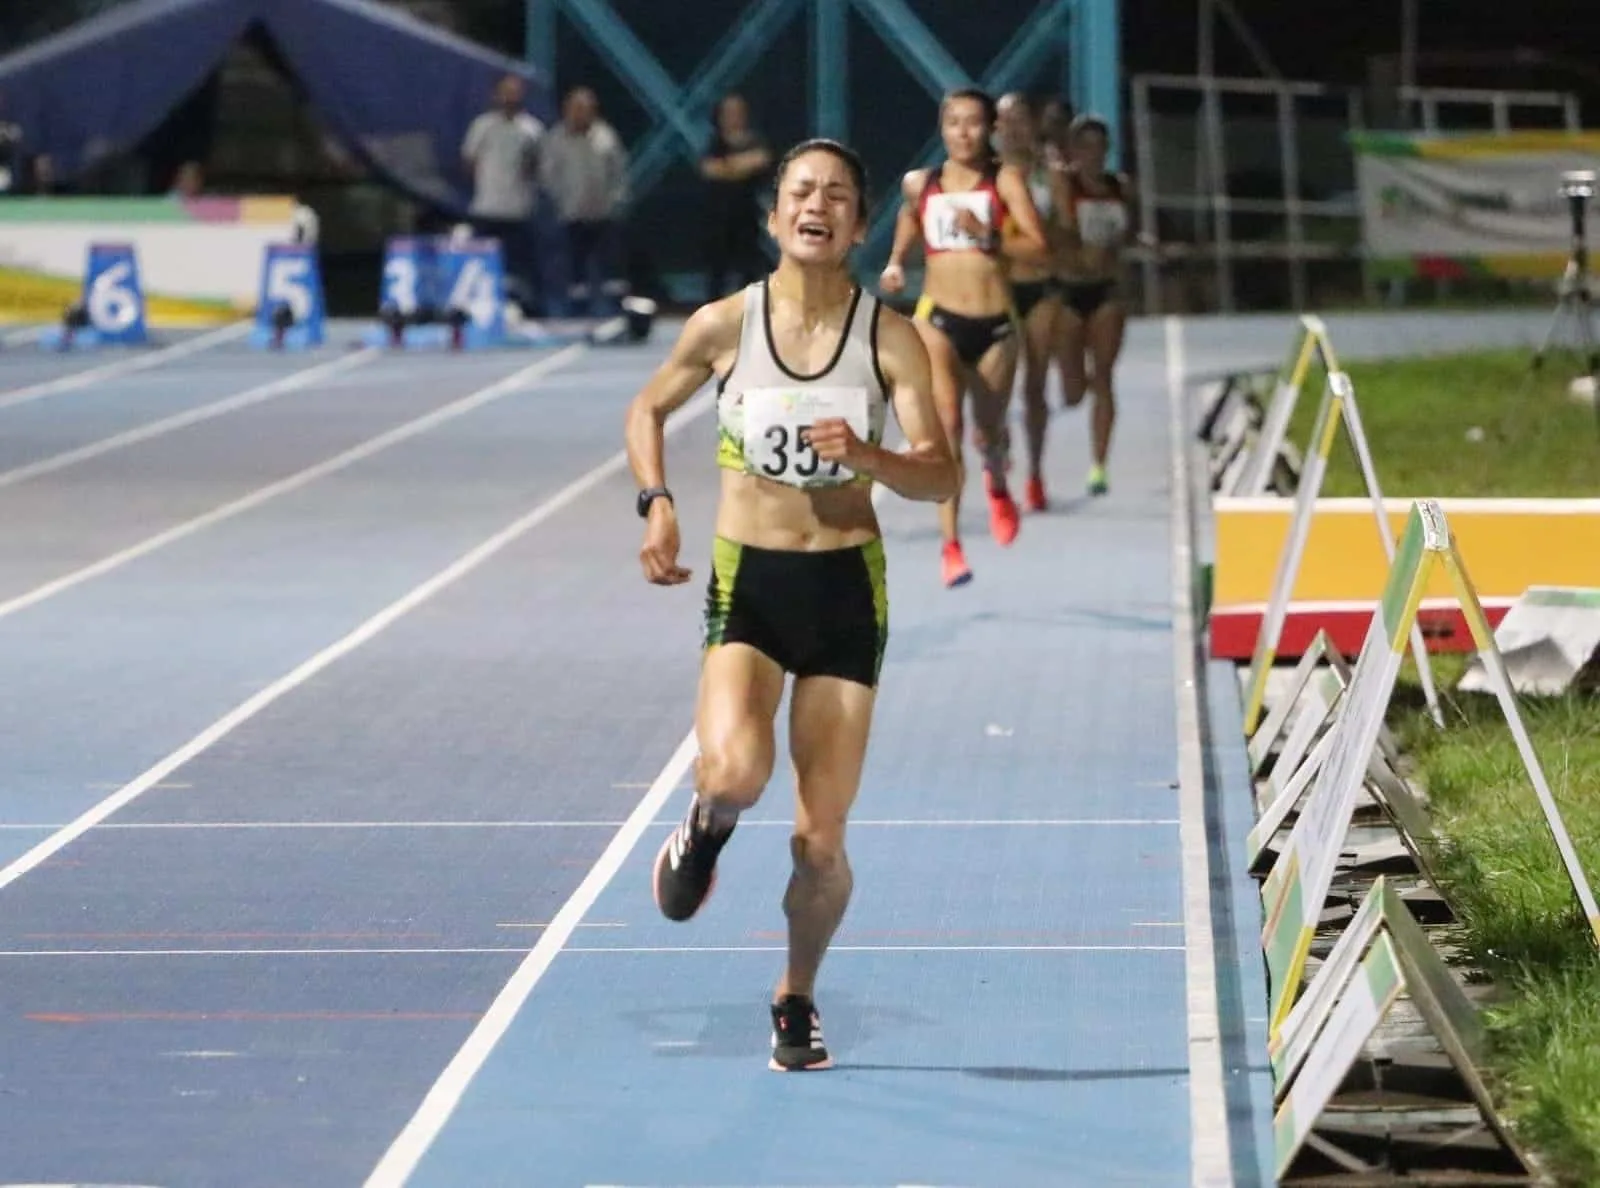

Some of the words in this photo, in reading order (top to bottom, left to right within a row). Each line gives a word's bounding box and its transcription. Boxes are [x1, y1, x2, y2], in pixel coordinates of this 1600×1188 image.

[89, 261, 138, 332] 6
[268, 258, 312, 324] 5
[449, 258, 496, 329] 4
